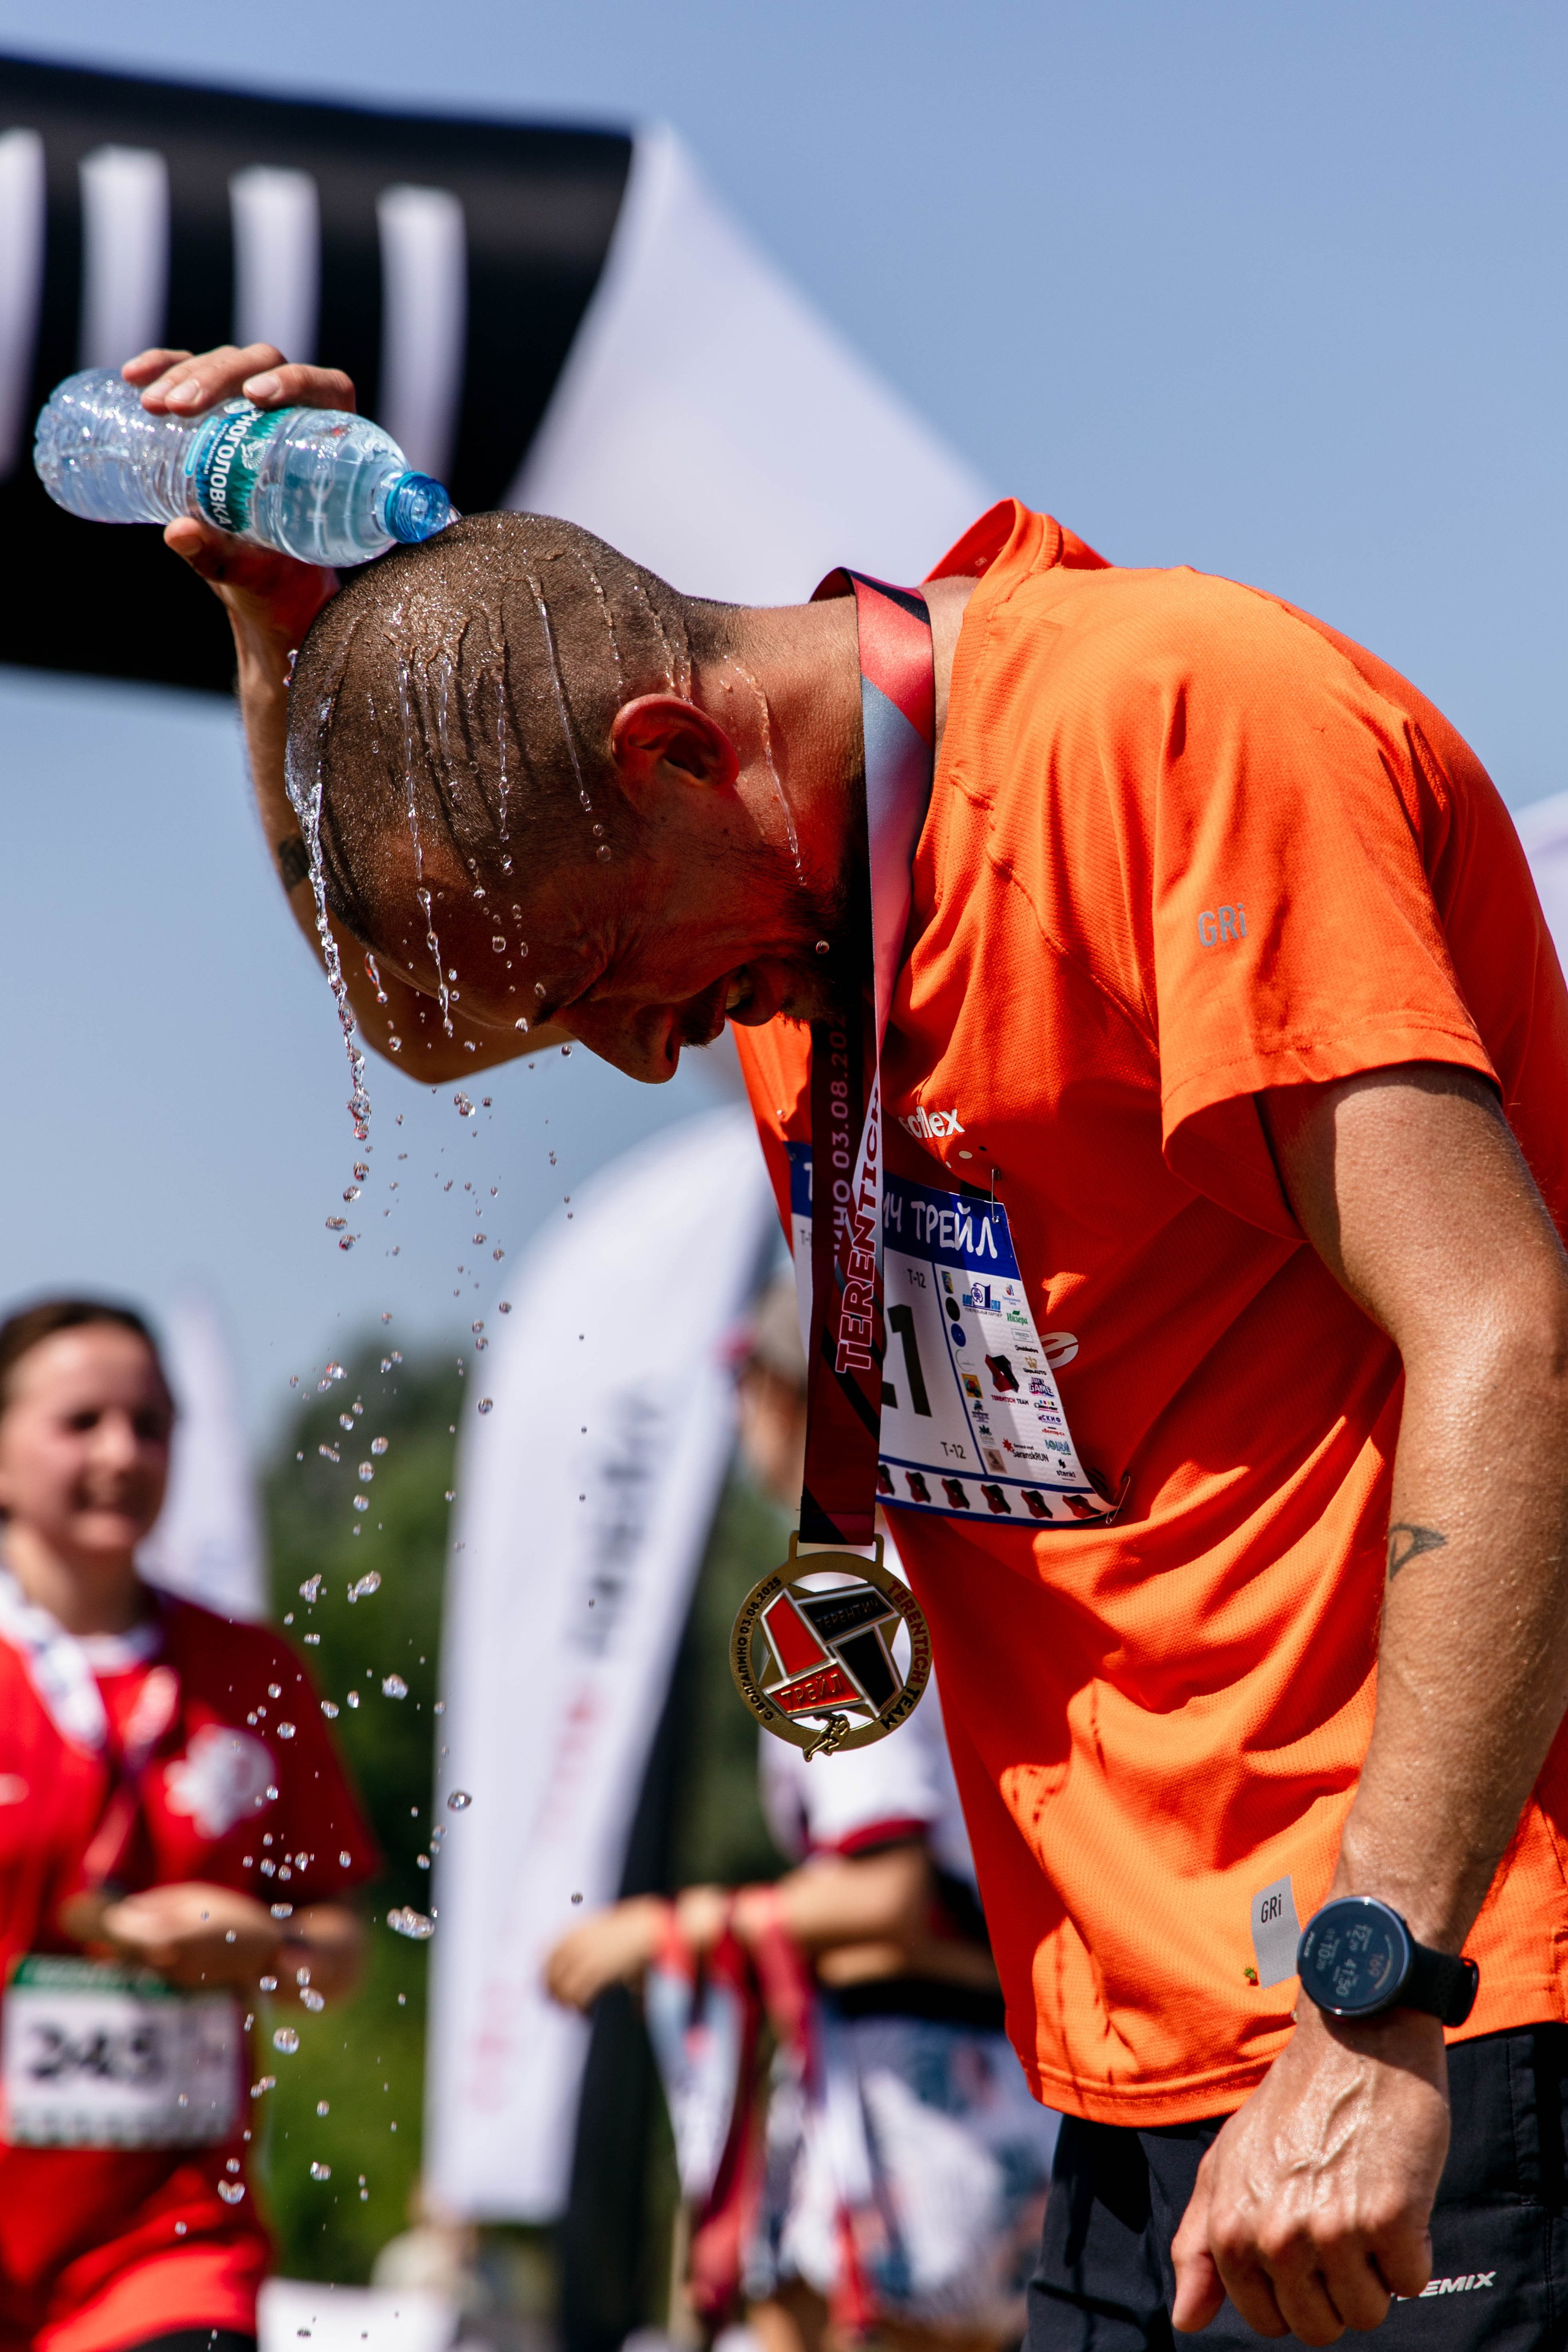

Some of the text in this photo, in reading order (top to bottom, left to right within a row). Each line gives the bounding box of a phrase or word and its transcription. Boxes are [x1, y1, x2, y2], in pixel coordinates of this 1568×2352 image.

[1198, 903, 1246, 947] GRi
[910, 1201, 998, 1259] ТРЕЙЛ
[990, 1395, 1016, 1403] TERENTICH
[1028, 1384, 1055, 1397] GAME
[1012, 1449, 1050, 1463] SaranskRUN
[739, 1576, 782, 1635] 03.08.2025
[815, 1599, 878, 1630] ТЕРЕНТИЧ
[880, 1580, 930, 1732] TERENTICH TEAM
[780, 1673, 842, 1708] ТРЕЙЛ
[1261, 1893, 1282, 1924] GRi
[1396, 2271, 1496, 2301] EMIX
